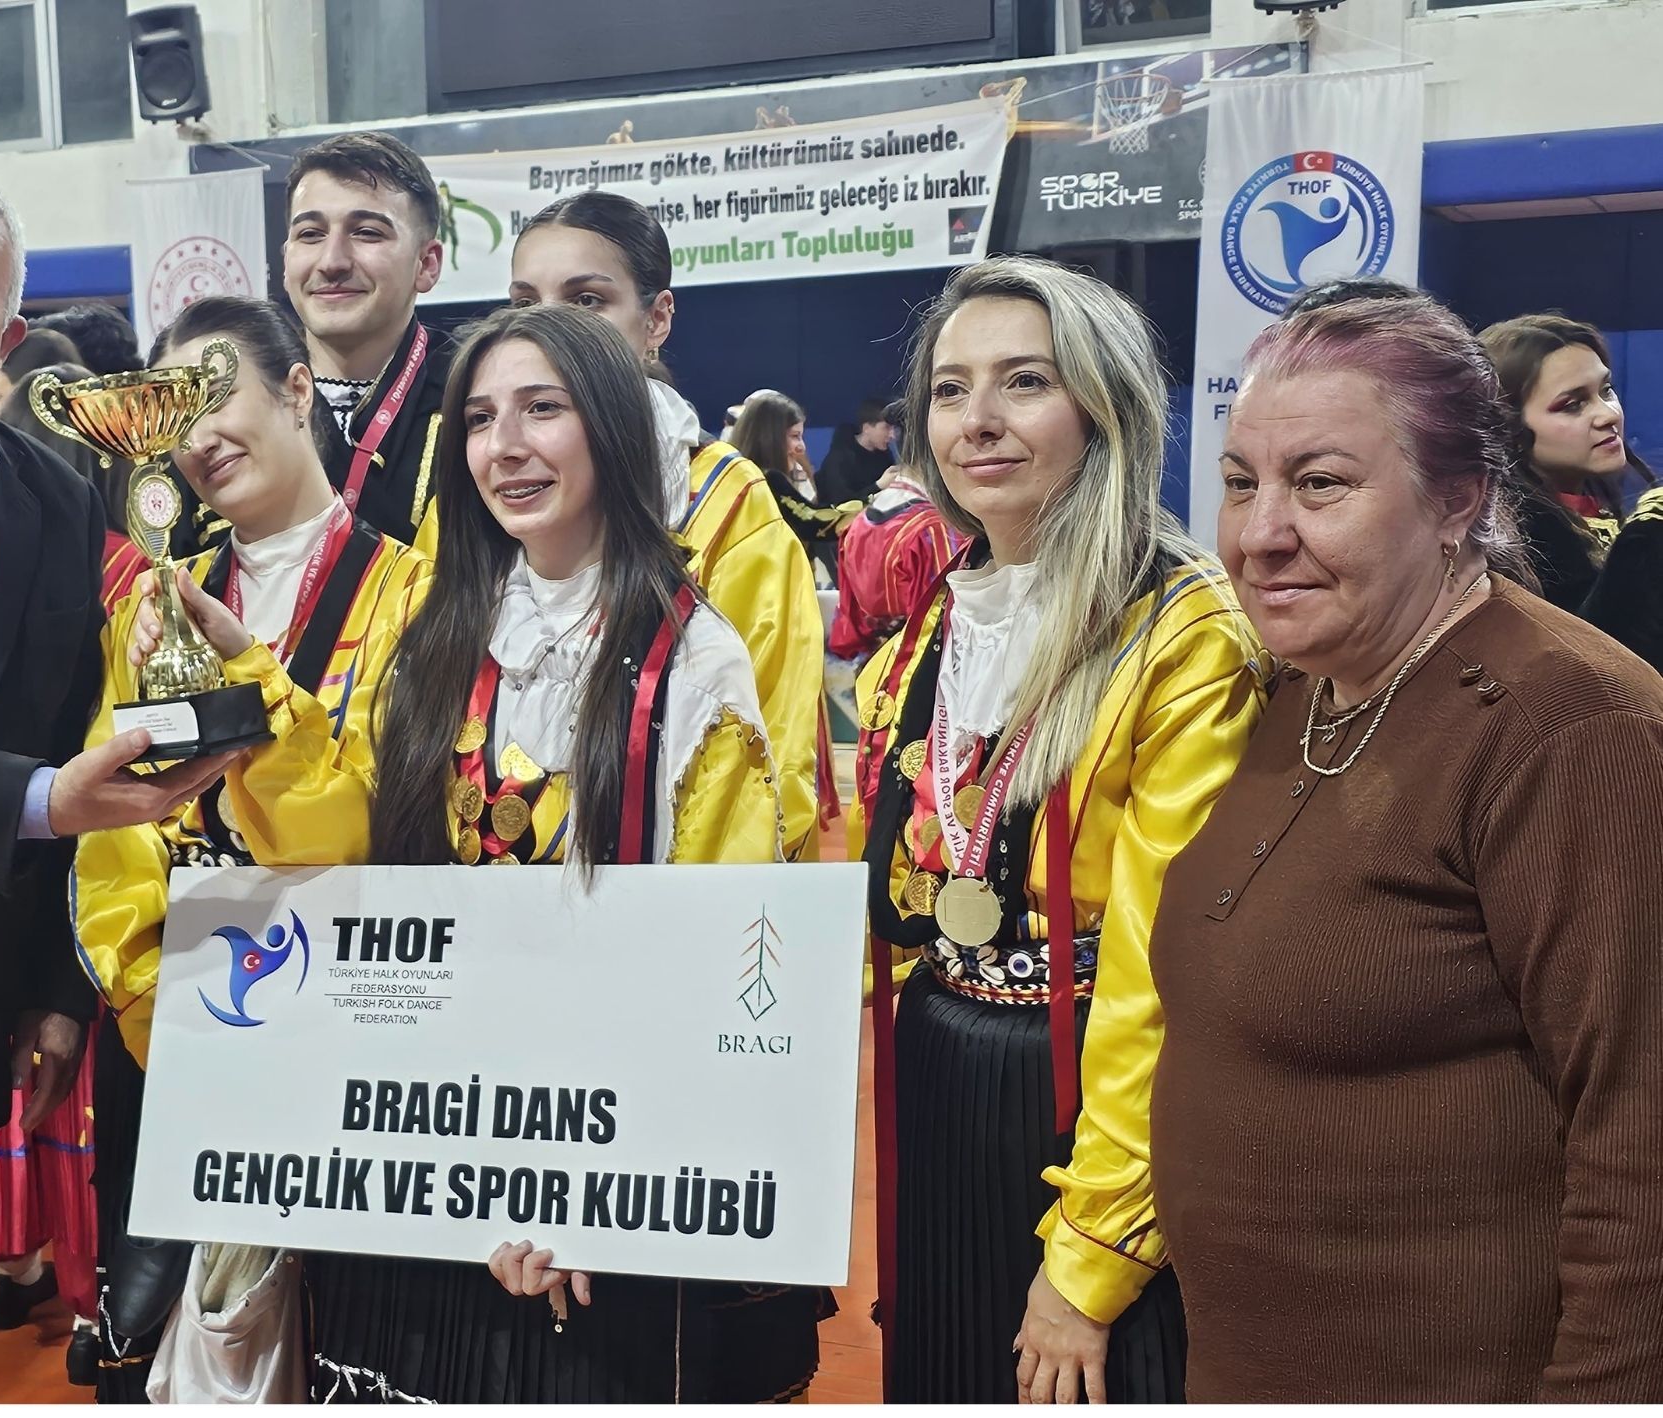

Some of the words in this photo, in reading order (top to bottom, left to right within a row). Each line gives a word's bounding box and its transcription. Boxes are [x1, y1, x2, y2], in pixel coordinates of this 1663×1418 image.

[529, 160, 644, 193] Bayrağımız
[650, 152, 717, 185] gökte,
[724, 136, 854, 171] kültürümüz
[860, 125, 966, 159] sahnede.
[1040, 171, 1121, 195] SPOR
[1287, 180, 1332, 195] THOF
[693, 194, 721, 219] her
[727, 185, 814, 222] figürümüz
[820, 176, 899, 216] geleceğe
[904, 175, 918, 201] iz
[1041, 184, 1163, 213] TÜRKİYE
[672, 236, 775, 273] oyunları
[782, 222, 915, 262] Topluluğu
[1207, 378, 1239, 394] HA
[973, 780, 1007, 867] CUMHURİYETİ
[332, 916, 456, 963] THOF
[328, 967, 370, 978] TÜRKİYE
[373, 969, 399, 979] HALK
[401, 969, 454, 980] OYUNLARI
[350, 984, 427, 995] FEDERASYONU
[333, 998, 376, 1009] TURKISH
[378, 999, 405, 1009] FOLK
[407, 1000, 443, 1010] DANCE
[354, 1013, 418, 1025] FEDERATION
[717, 1032, 793, 1056] BRAGI
[342, 1073, 481, 1138] BRAGİ
[491, 1084, 618, 1145] DANS
[193, 1146, 372, 1219] GENÇLİK
[384, 1159, 435, 1218] VE
[446, 1161, 572, 1227] SPOR
[582, 1166, 778, 1240] KULÜBÜ
